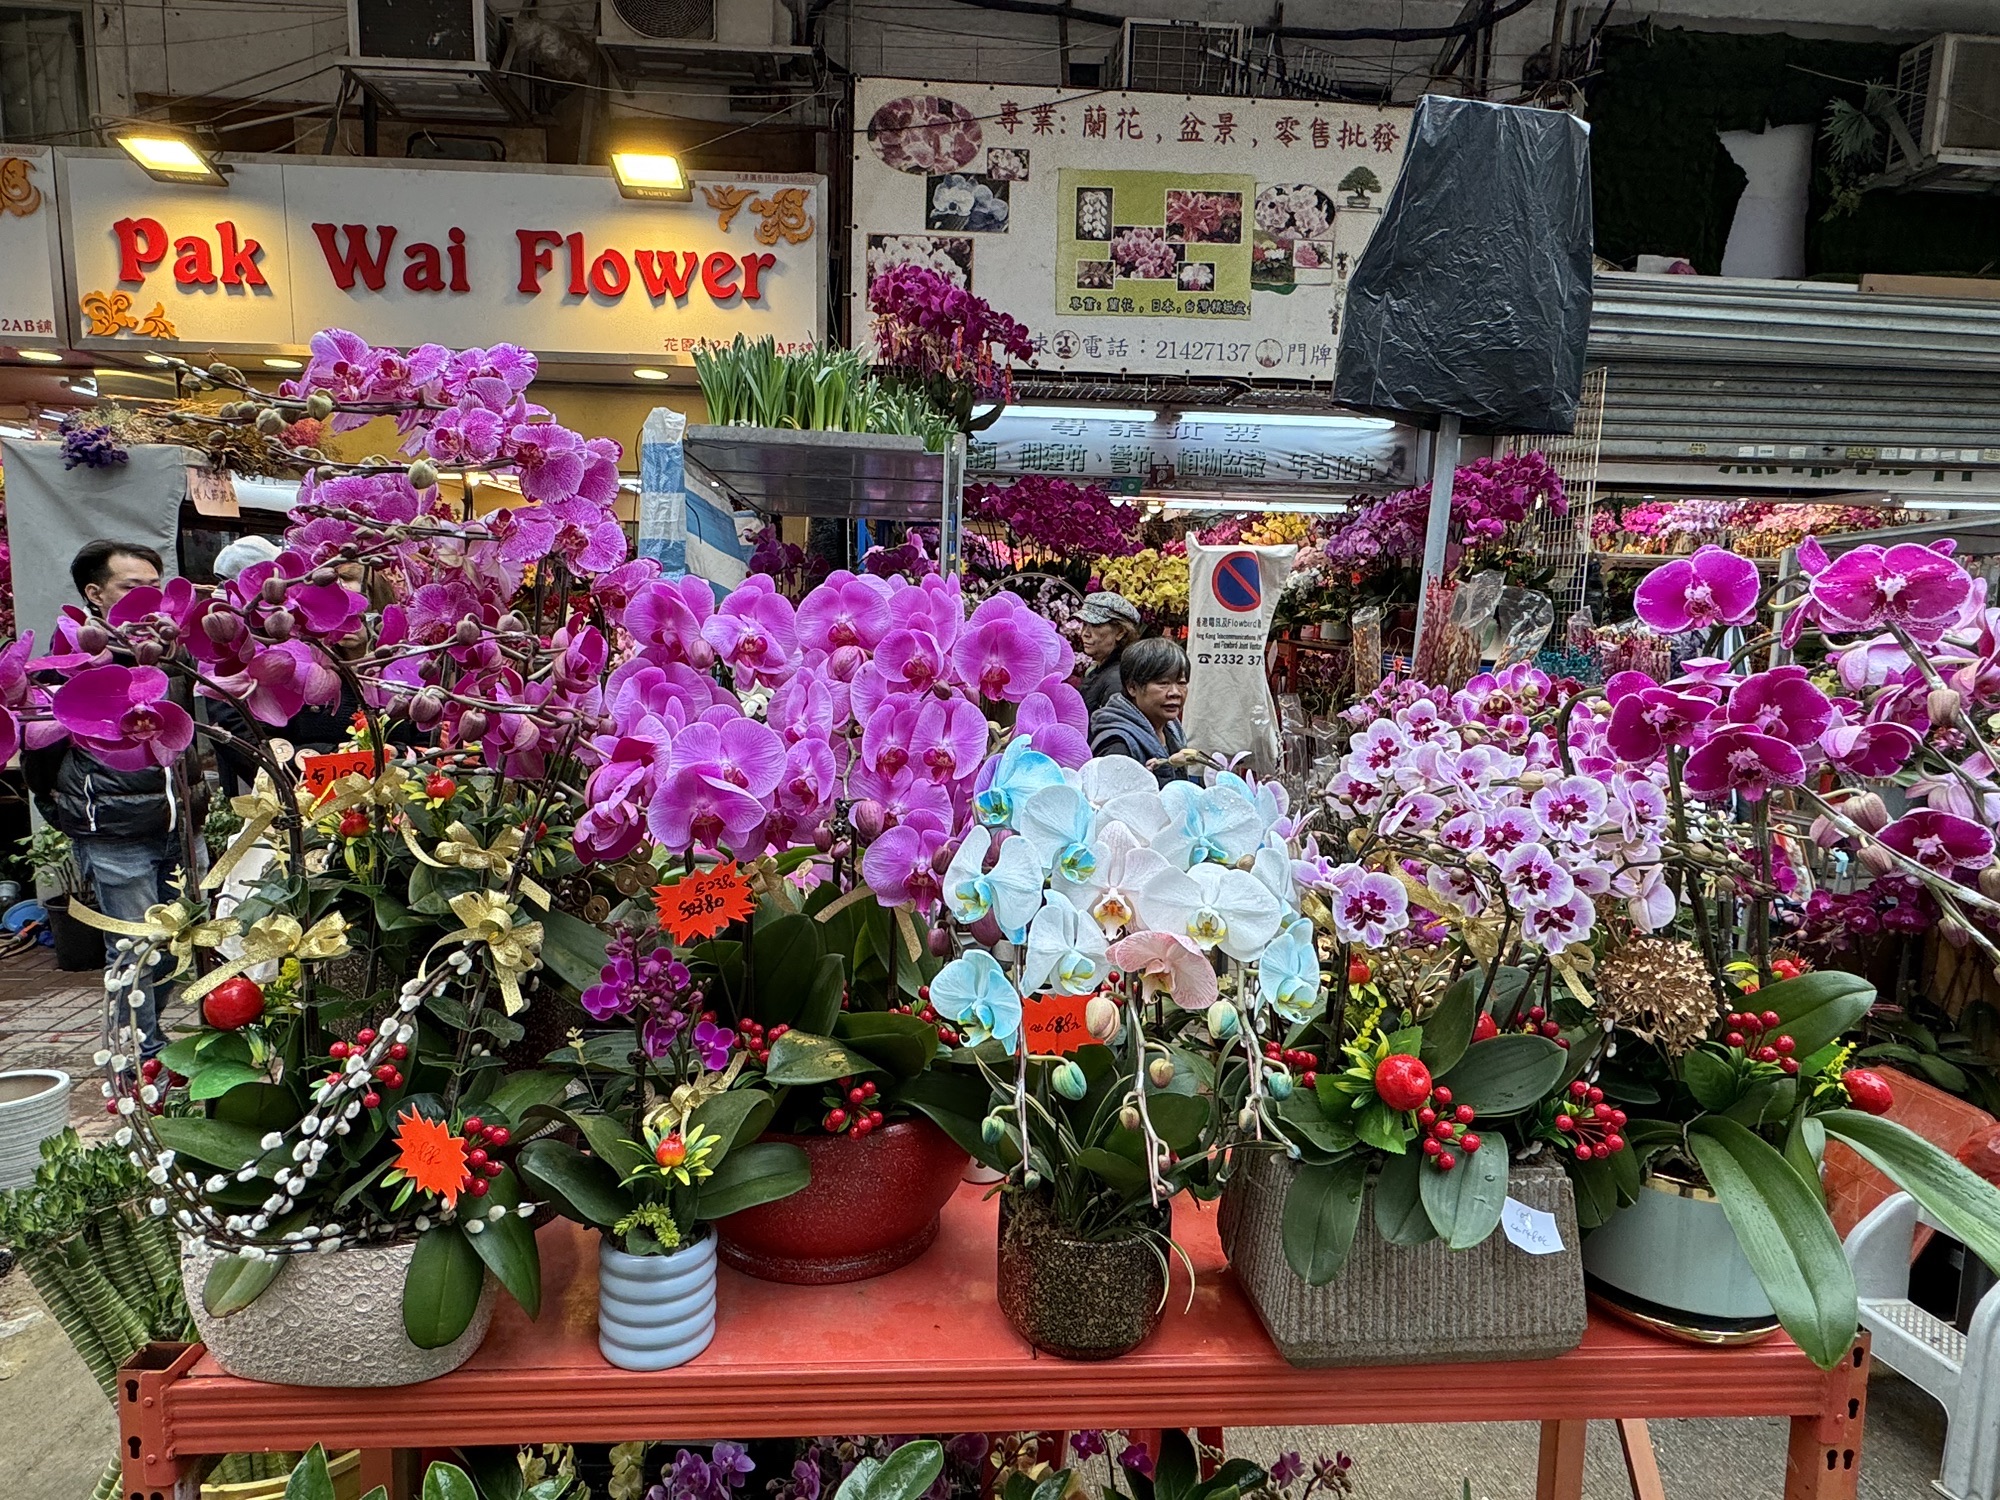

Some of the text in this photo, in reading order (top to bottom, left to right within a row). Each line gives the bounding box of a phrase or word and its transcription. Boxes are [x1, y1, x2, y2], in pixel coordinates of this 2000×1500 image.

[113, 216, 777, 300] Pak Wai Flower
[1214, 653, 1263, 665] 2332 37
